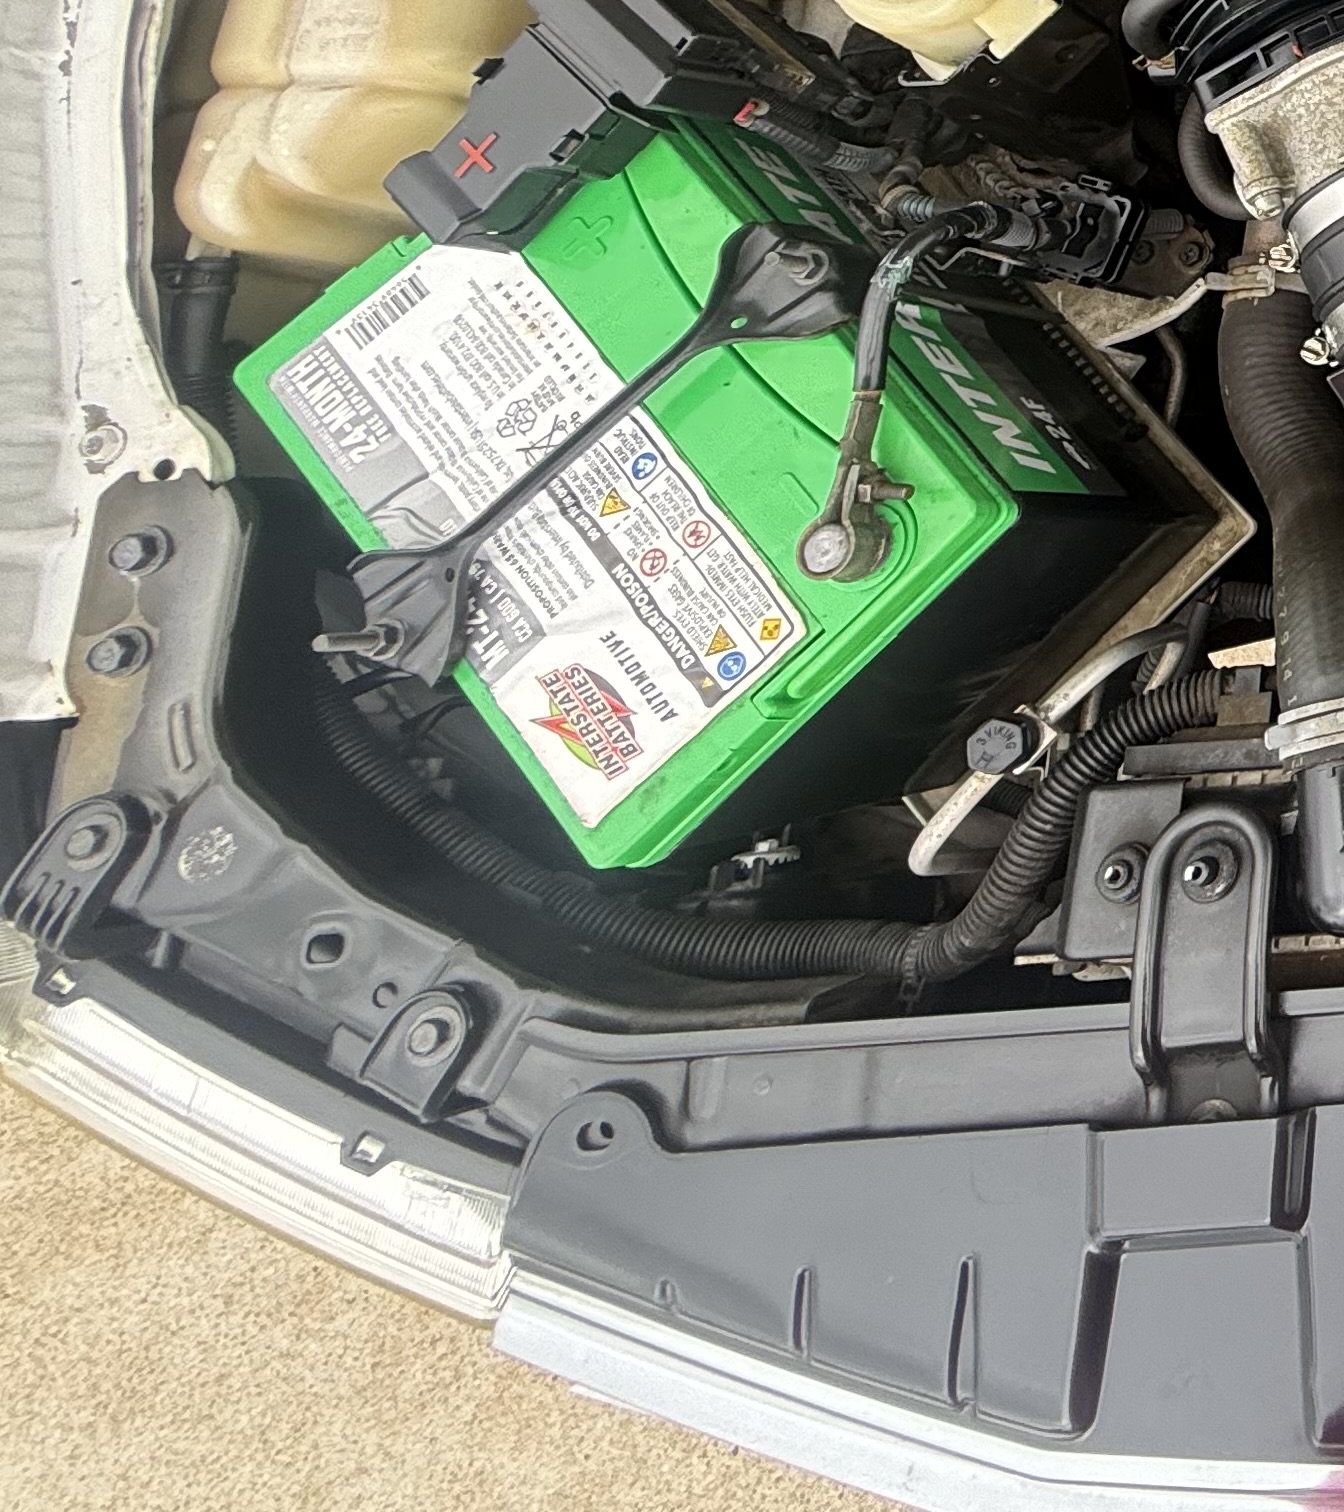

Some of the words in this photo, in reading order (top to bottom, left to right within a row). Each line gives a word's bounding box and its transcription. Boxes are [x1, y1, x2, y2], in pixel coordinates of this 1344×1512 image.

[312, 342, 373, 418] REPLACEMENT
[285, 351, 382, 466] 24-MONTH
[1020, 396, 1069, 441] 24F
[363, 411, 393, 444] FREE
[612, 443, 630, 464] READ
[654, 499, 670, 516] OUT
[660, 488, 680, 512] REACH
[664, 512, 682, 532] KEEP
[705, 546, 720, 563] GET
[733, 564, 752, 584] HELP
[514, 563, 559, 620] PROPOSITION
[666, 582, 687, 606] GASES
[723, 588, 741, 607] EYES
[732, 581, 751, 602] WITH
[746, 580, 773, 612] MEDICAL
[494, 595, 521, 624] 600
[609, 560, 696, 671] DANGER/POISON
[681, 600, 713, 639] EXPLOSIVE
[735, 603, 757, 628] FLUSH
[744, 597, 766, 620] ATELY
[507, 616, 534, 643] CCA
[684, 624, 708, 652] SHIELD
[598, 626, 678, 725] AUTOMOTIVE
[539, 670, 626, 778] INTERSTATE
[561, 663, 638, 760] BATTERIES
[981, 717, 1023, 753] VIKING
